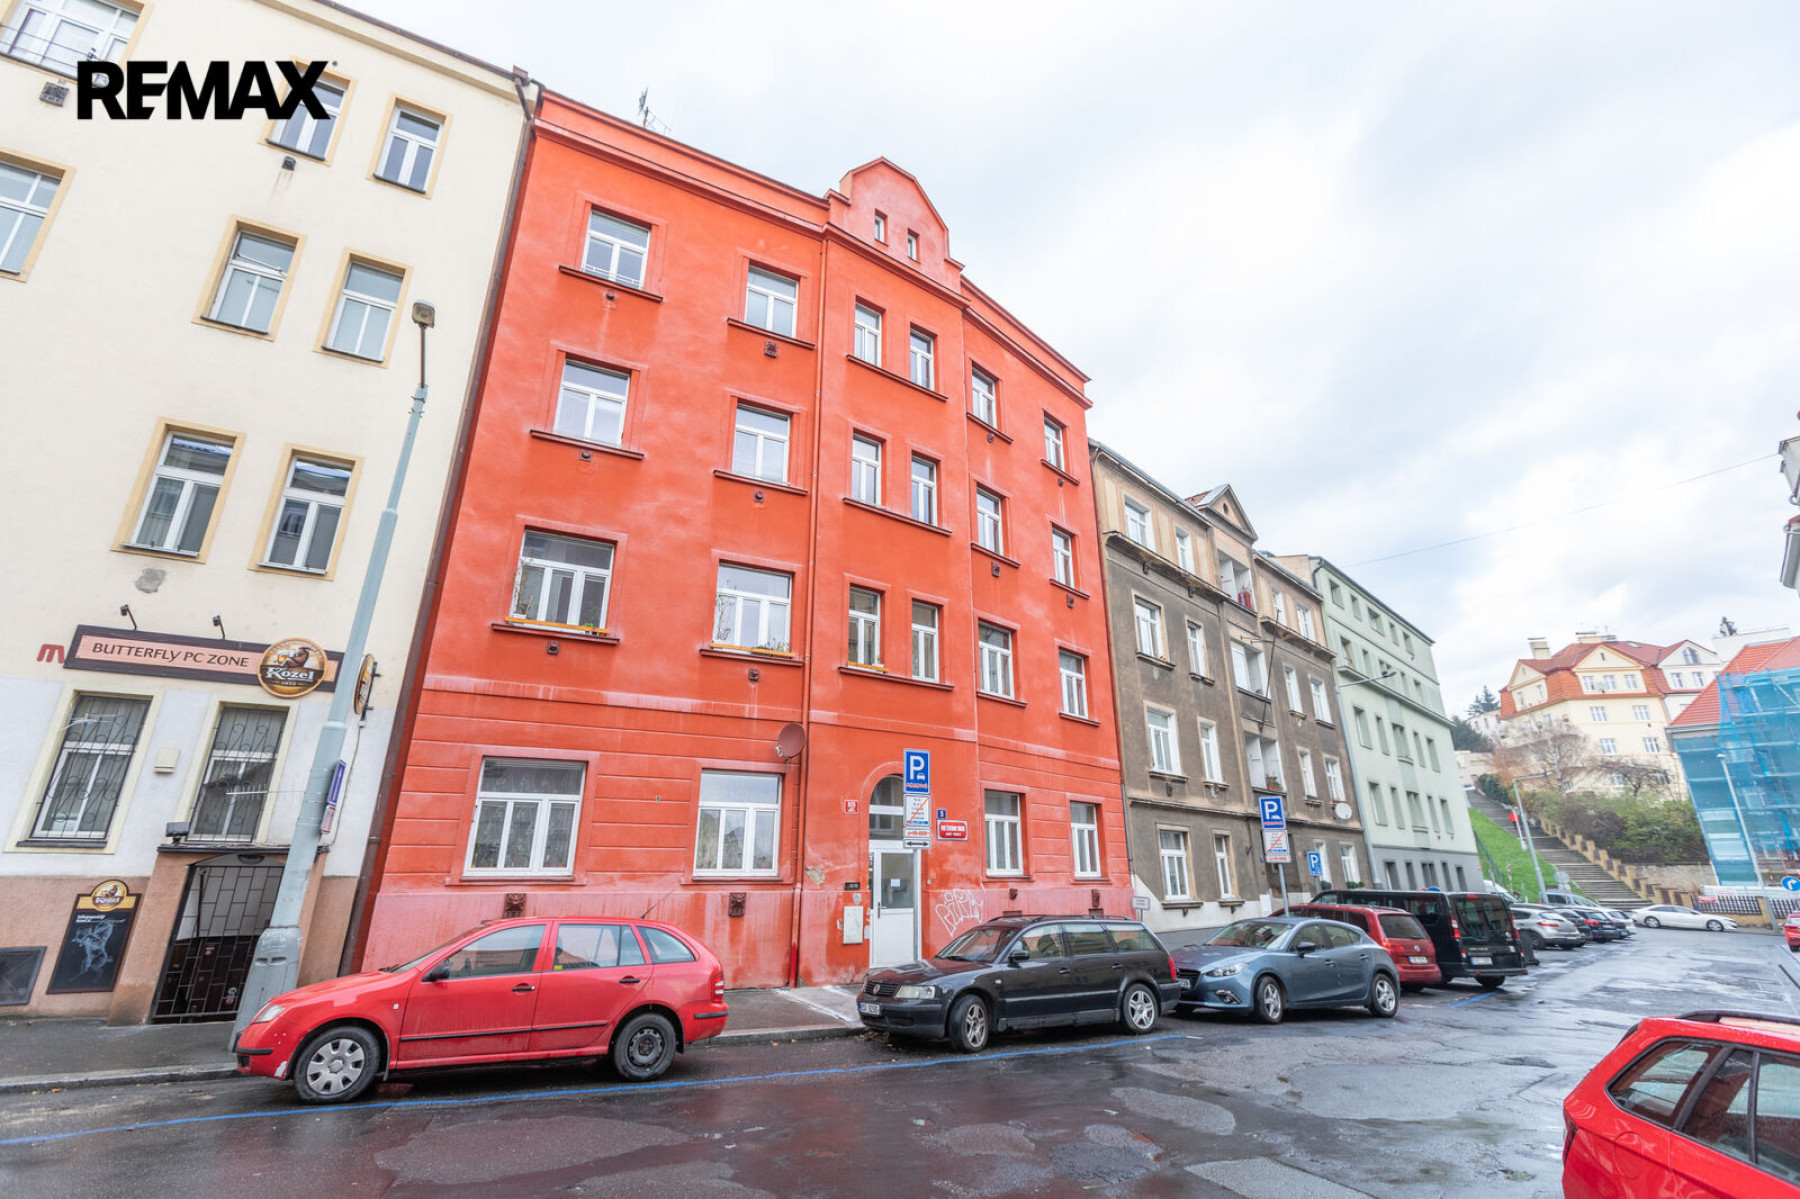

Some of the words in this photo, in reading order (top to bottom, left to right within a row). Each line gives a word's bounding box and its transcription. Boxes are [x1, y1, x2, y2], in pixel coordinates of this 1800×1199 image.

[92, 642, 182, 662] BUTTERFLY
[183, 652, 204, 663] PC
[207, 655, 249, 667] ZONE
[265, 666, 315, 683] Kozel
[910, 755, 925, 780] P
[1264, 801, 1278, 820] P
[1310, 854, 1319, 869] P
